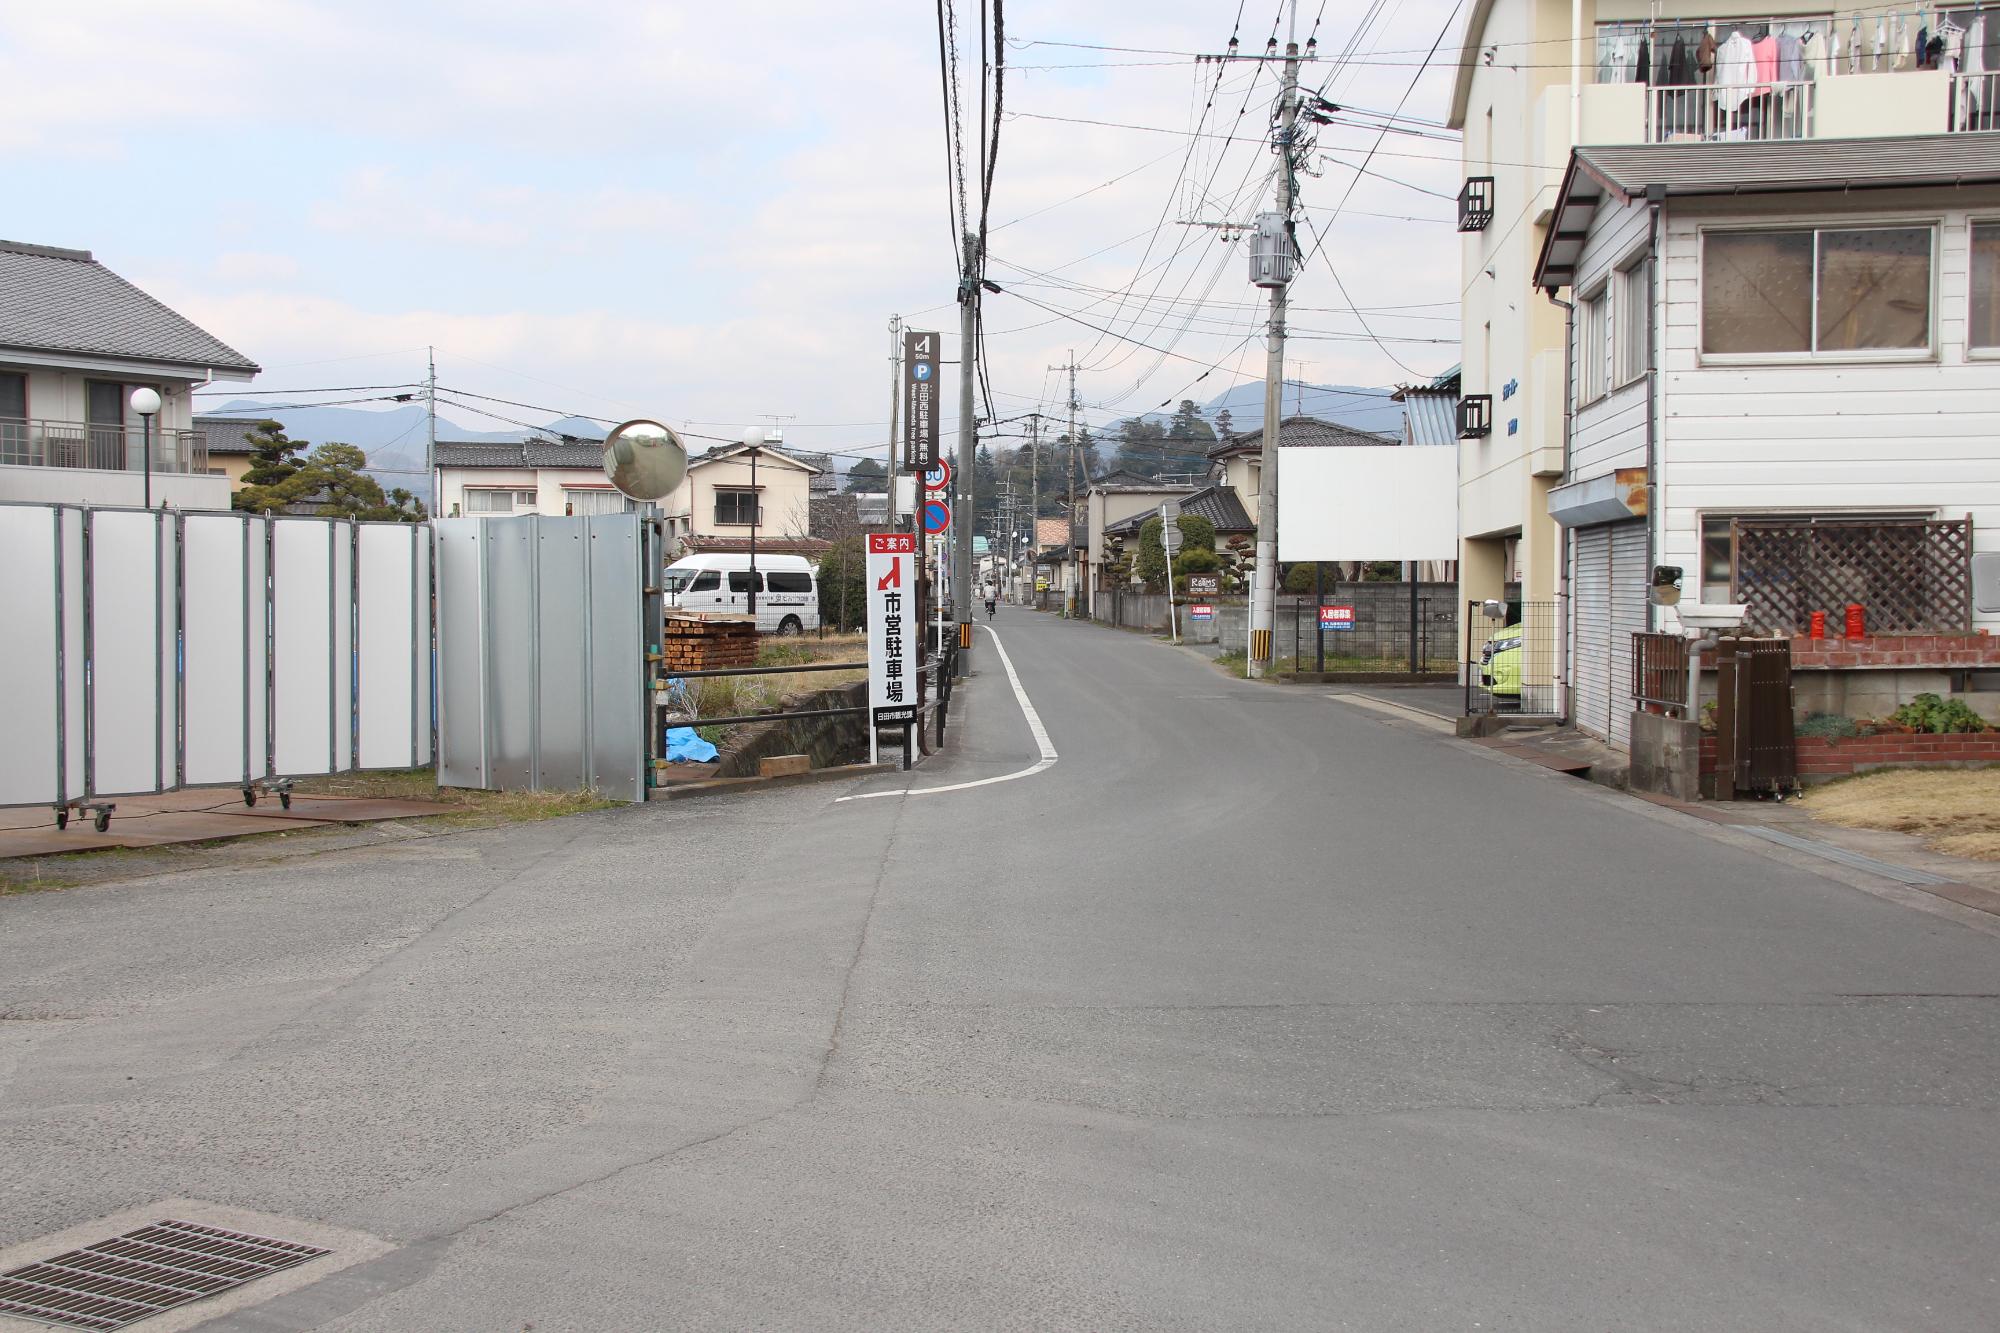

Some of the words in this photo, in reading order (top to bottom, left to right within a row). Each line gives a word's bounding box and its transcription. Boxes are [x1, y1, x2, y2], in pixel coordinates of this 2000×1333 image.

[917, 365, 928, 378] P
[875, 537, 909, 550] ご案内
[1321, 609, 1351, 619] 入居者募集
[884, 591, 903, 703] 市営駐車場
